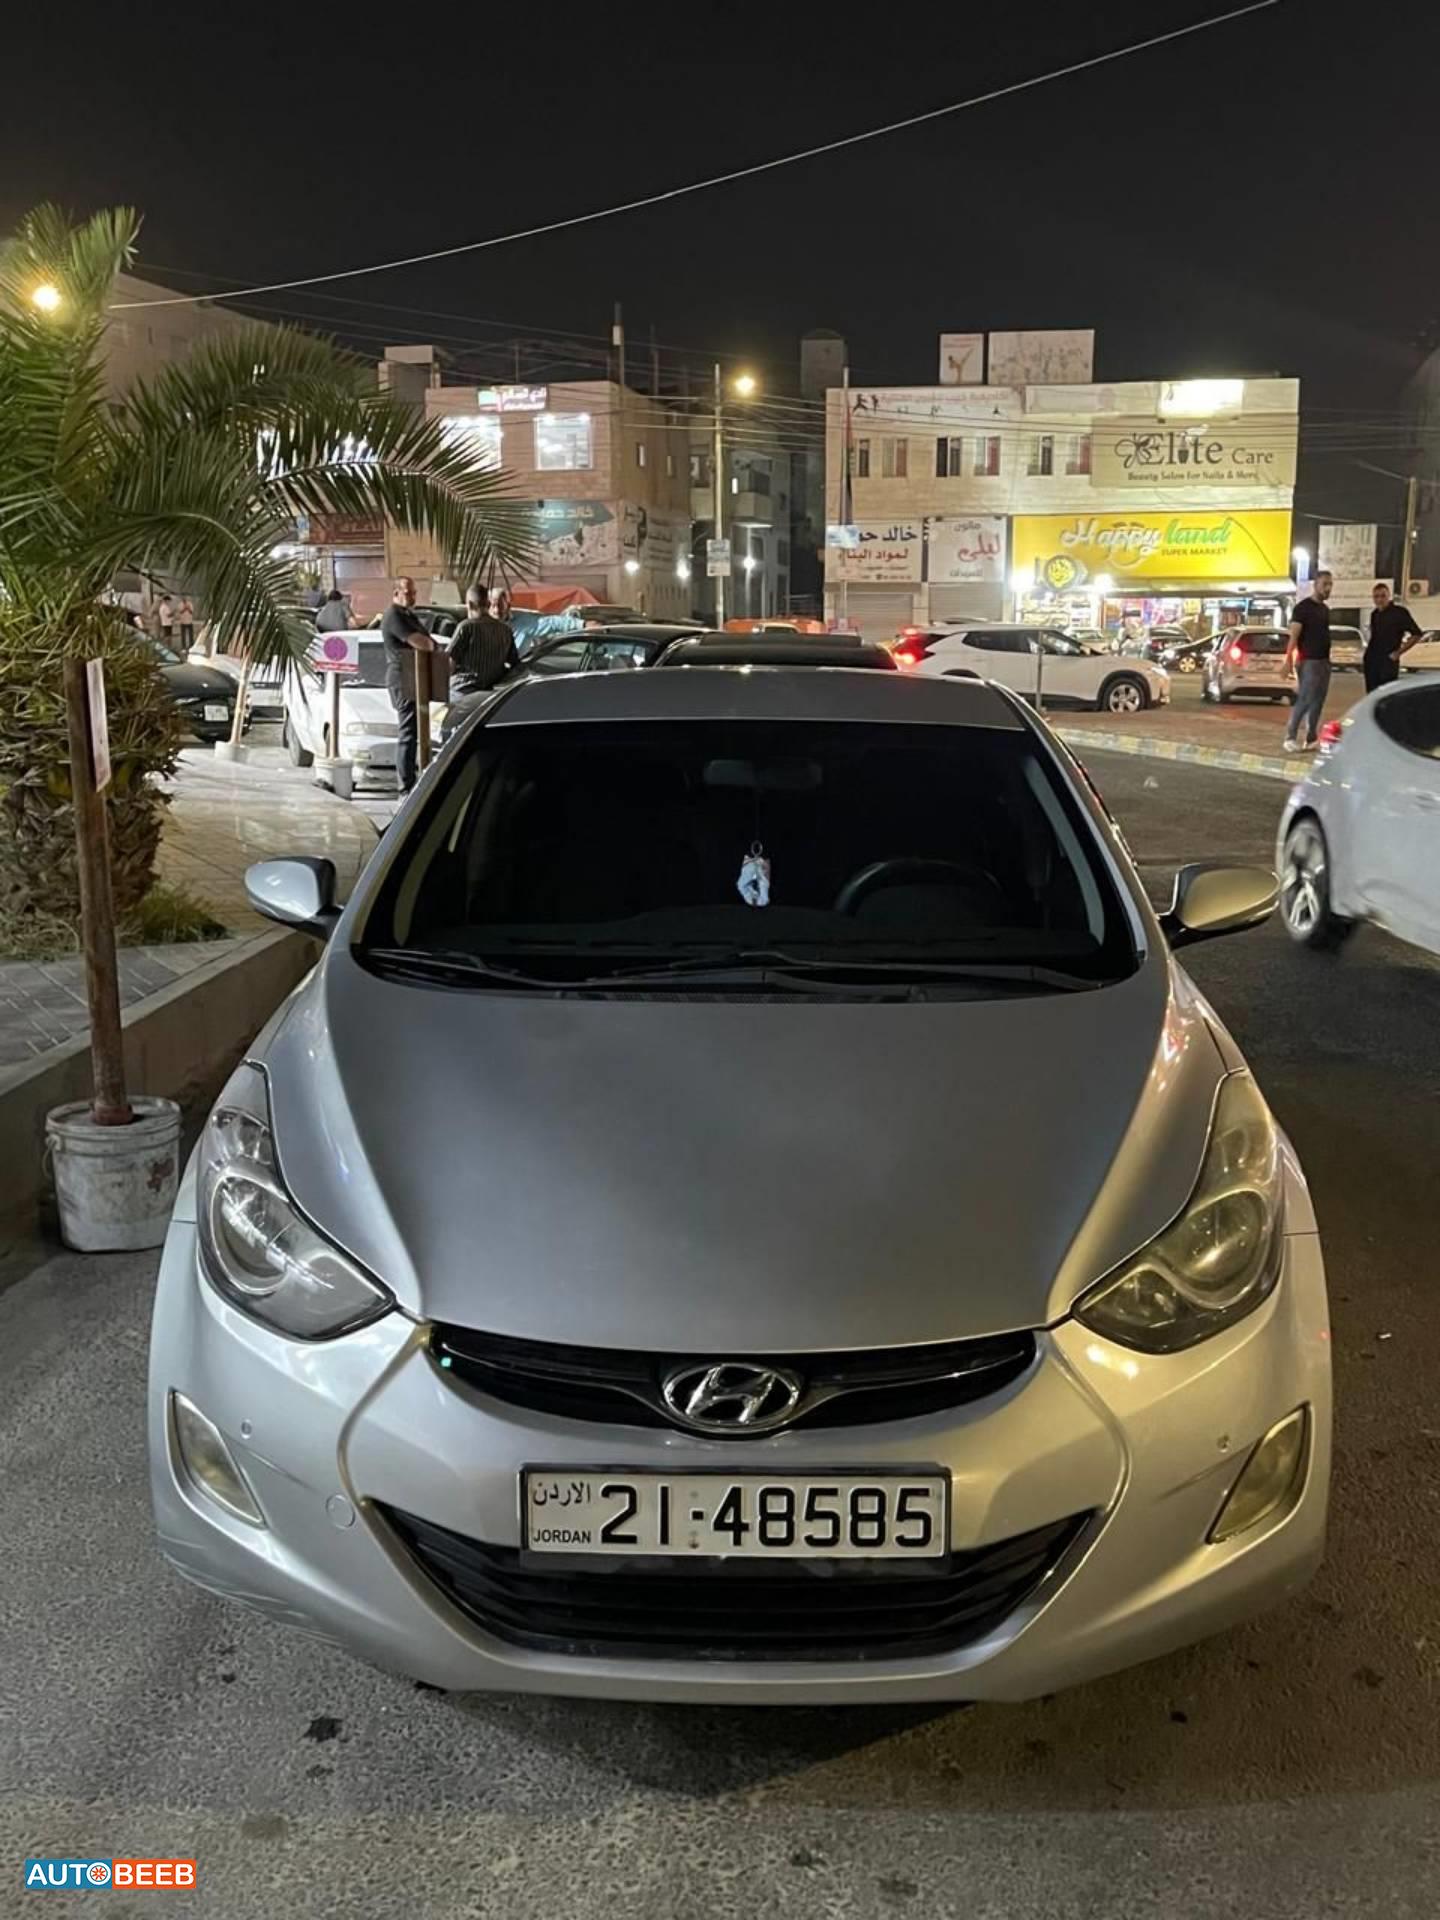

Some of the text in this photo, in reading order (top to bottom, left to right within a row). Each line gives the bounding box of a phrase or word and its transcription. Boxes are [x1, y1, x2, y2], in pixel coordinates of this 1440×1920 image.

[1231, 447, 1274, 465] Care
[882, 525, 918, 542] خالد
[1060, 518, 1161, 557] Happy
[1161, 547, 1228, 556] SUPER MARKET
[532, 1529, 592, 1545] JORDAN
